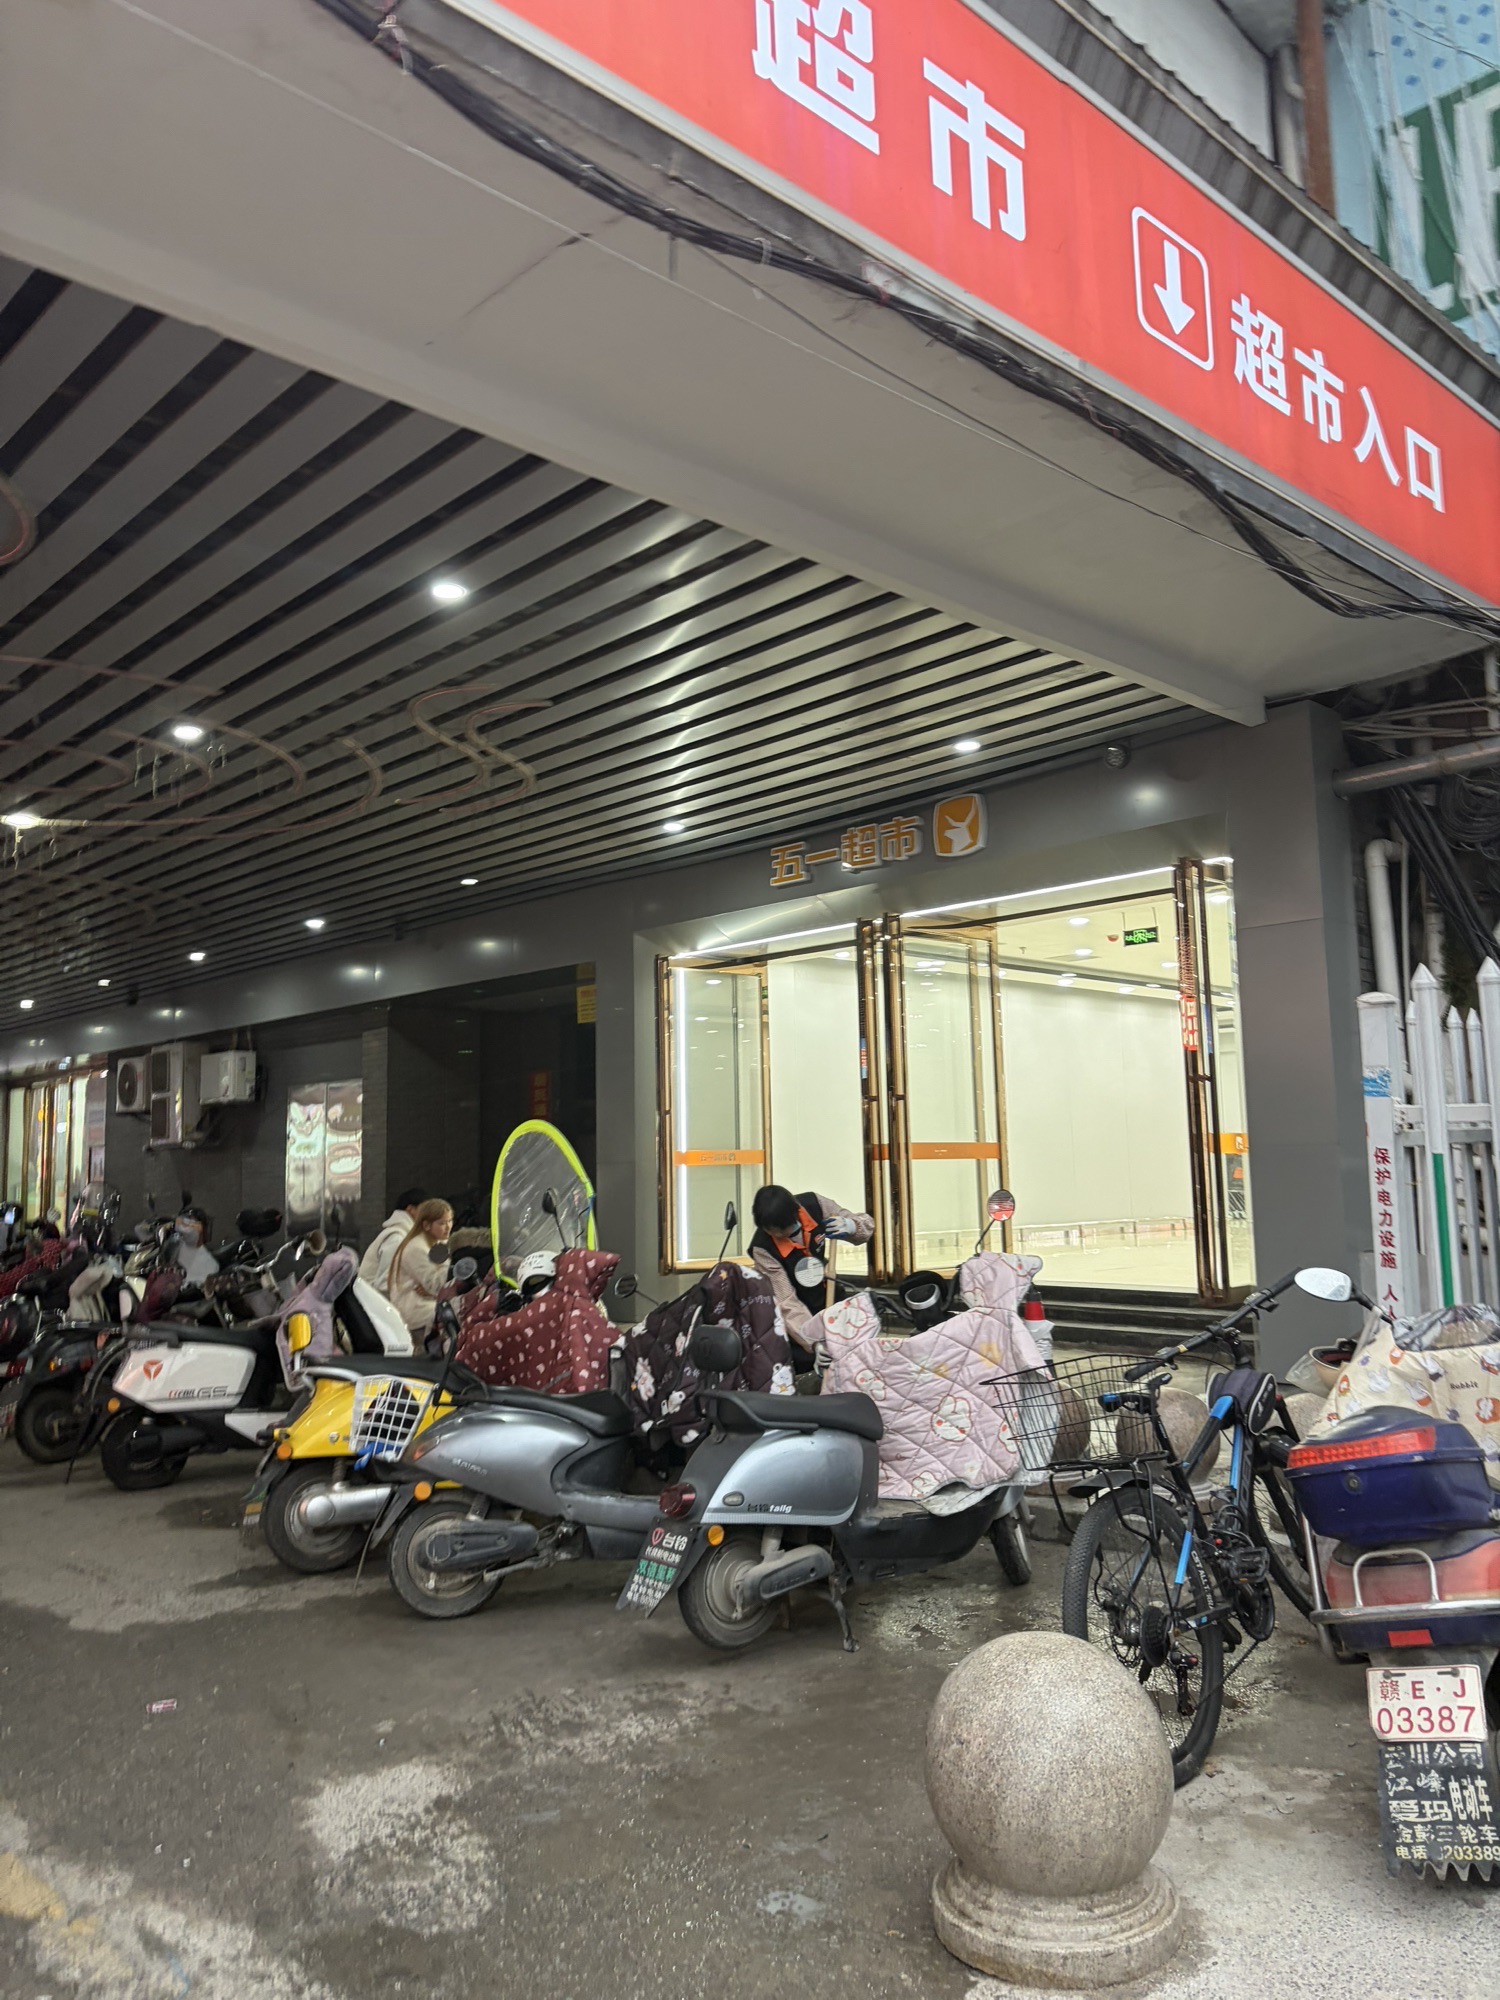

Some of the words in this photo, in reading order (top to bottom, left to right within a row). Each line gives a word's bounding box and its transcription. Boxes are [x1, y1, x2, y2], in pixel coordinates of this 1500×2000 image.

[750, 0, 1027, 242] 超市
[1230, 294, 1446, 513] 超市入口
[770, 815, 925, 888] 五一超市
[1373, 1146, 1398, 1270] 保护电力设施
[1377, 1705, 1476, 1735] 03387
[1396, 1845, 1428, 1860] 电话
[1437, 1845, 1500, 1861] 203389
